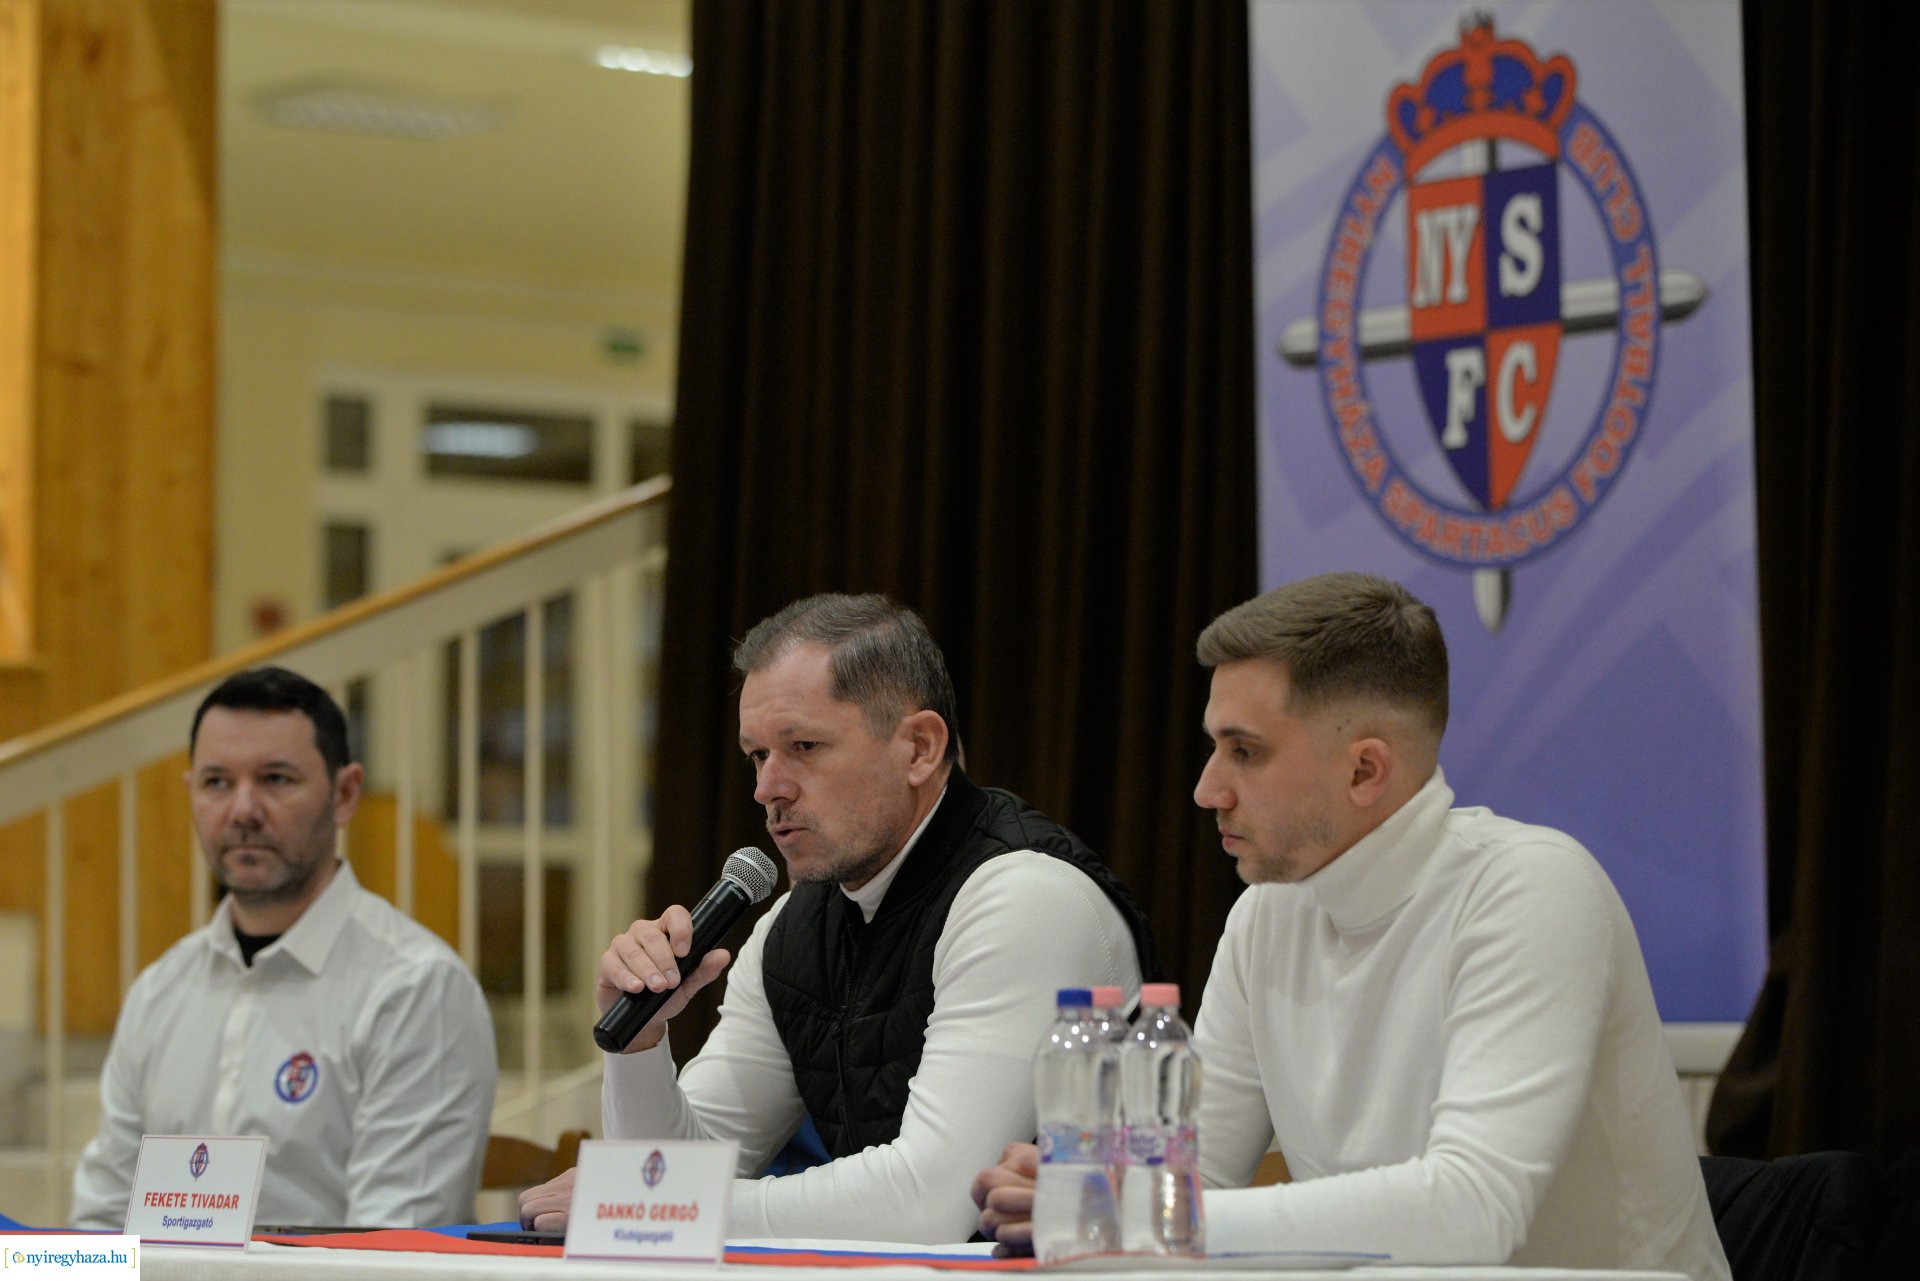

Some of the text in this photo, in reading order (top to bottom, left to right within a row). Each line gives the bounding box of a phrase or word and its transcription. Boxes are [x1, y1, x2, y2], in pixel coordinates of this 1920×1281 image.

[1566, 121, 1643, 244] CLUB
[1413, 193, 1544, 309] NY S
[1441, 340, 1538, 450] F C
[1569, 243, 1655, 504] FOOTBALL
[1382, 478, 1578, 561] SPARTACUS
[144, 1191, 240, 1210] FEKETE TIVADAR
[162, 1215, 214, 1230] Sportigazgató
[596, 1200, 646, 1221] DANKÓ
